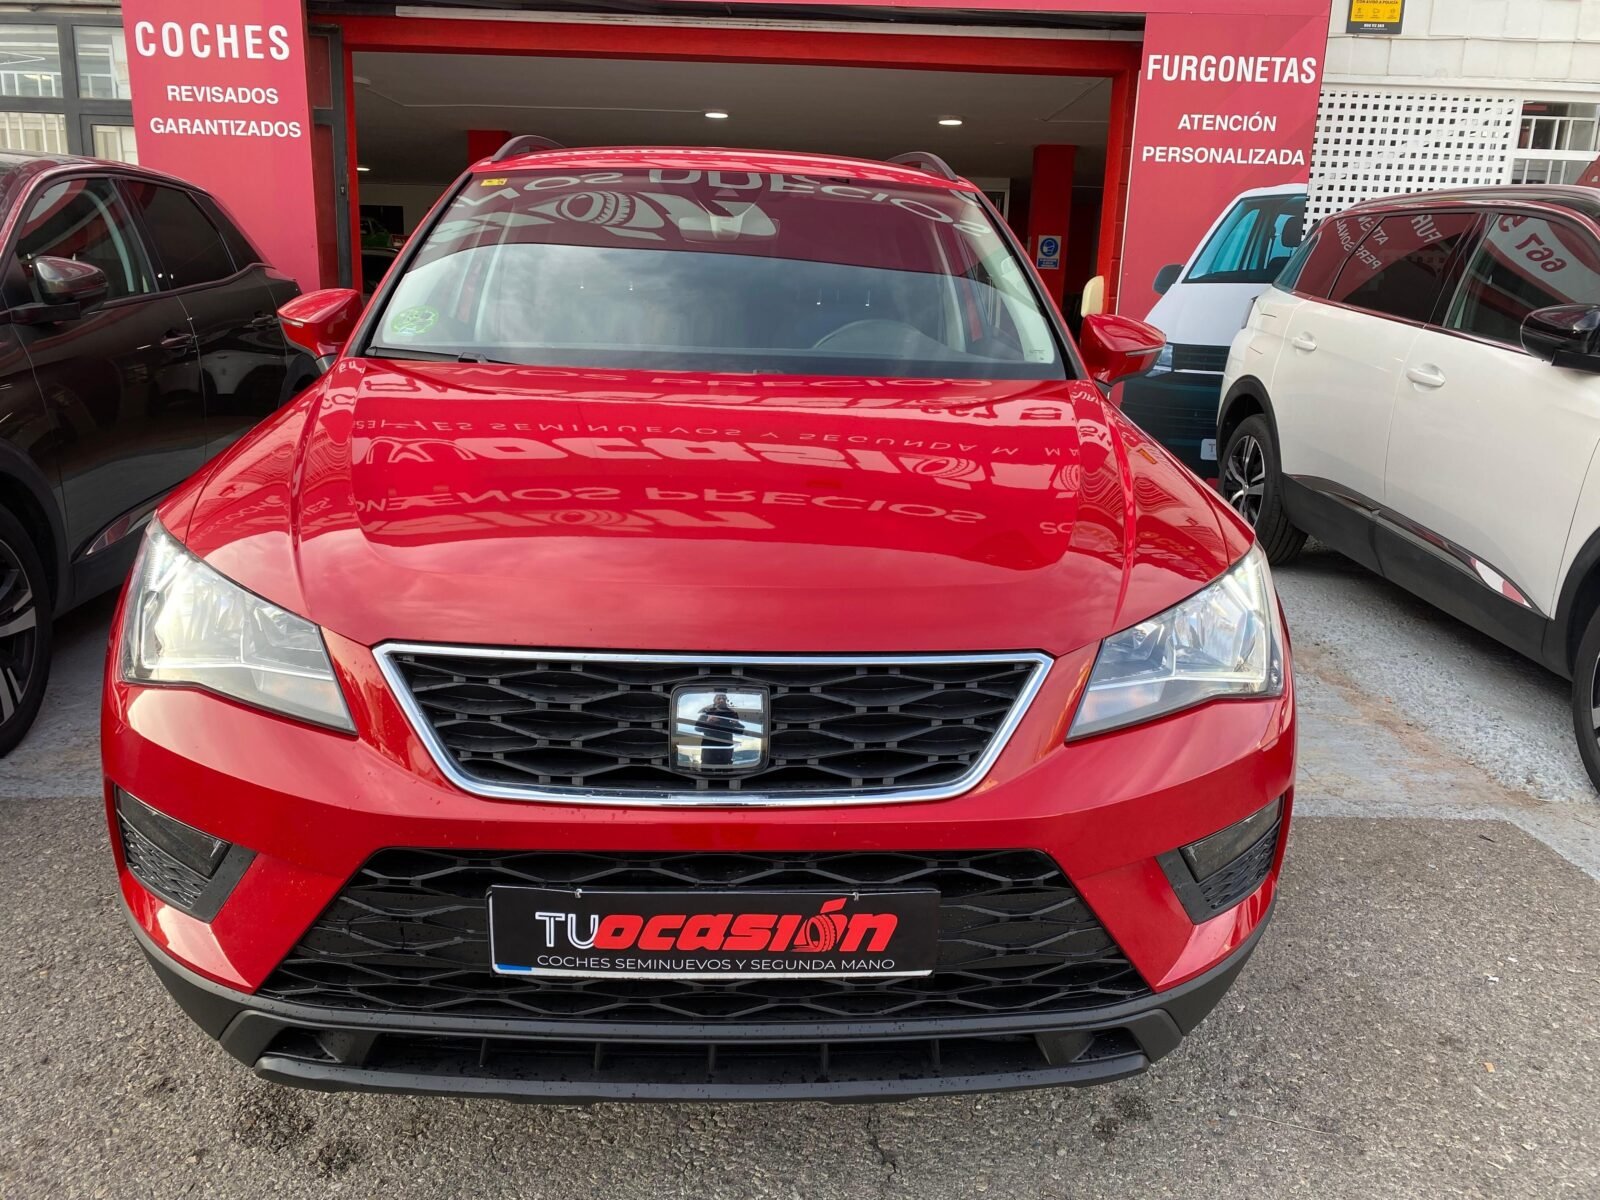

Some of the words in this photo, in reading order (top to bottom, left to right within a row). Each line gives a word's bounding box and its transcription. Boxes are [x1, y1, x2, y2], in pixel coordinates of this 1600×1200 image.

[135, 21, 290, 60] COCHES
[1147, 55, 1317, 84] FURGONETAS
[167, 85, 279, 105] REVISADOS
[150, 117, 301, 138] GARANTIZADOS
[1177, 111, 1277, 132] ATENCIÓN
[1142, 146, 1305, 166] PERSONALIZADA
[537, 955, 611, 969] COCHES
[615, 957, 732, 970] SEMINUEVOS
[735, 959, 748, 970] Y
[750, 959, 837, 970] SEGUNDA
[841, 959, 895, 970] MANO
